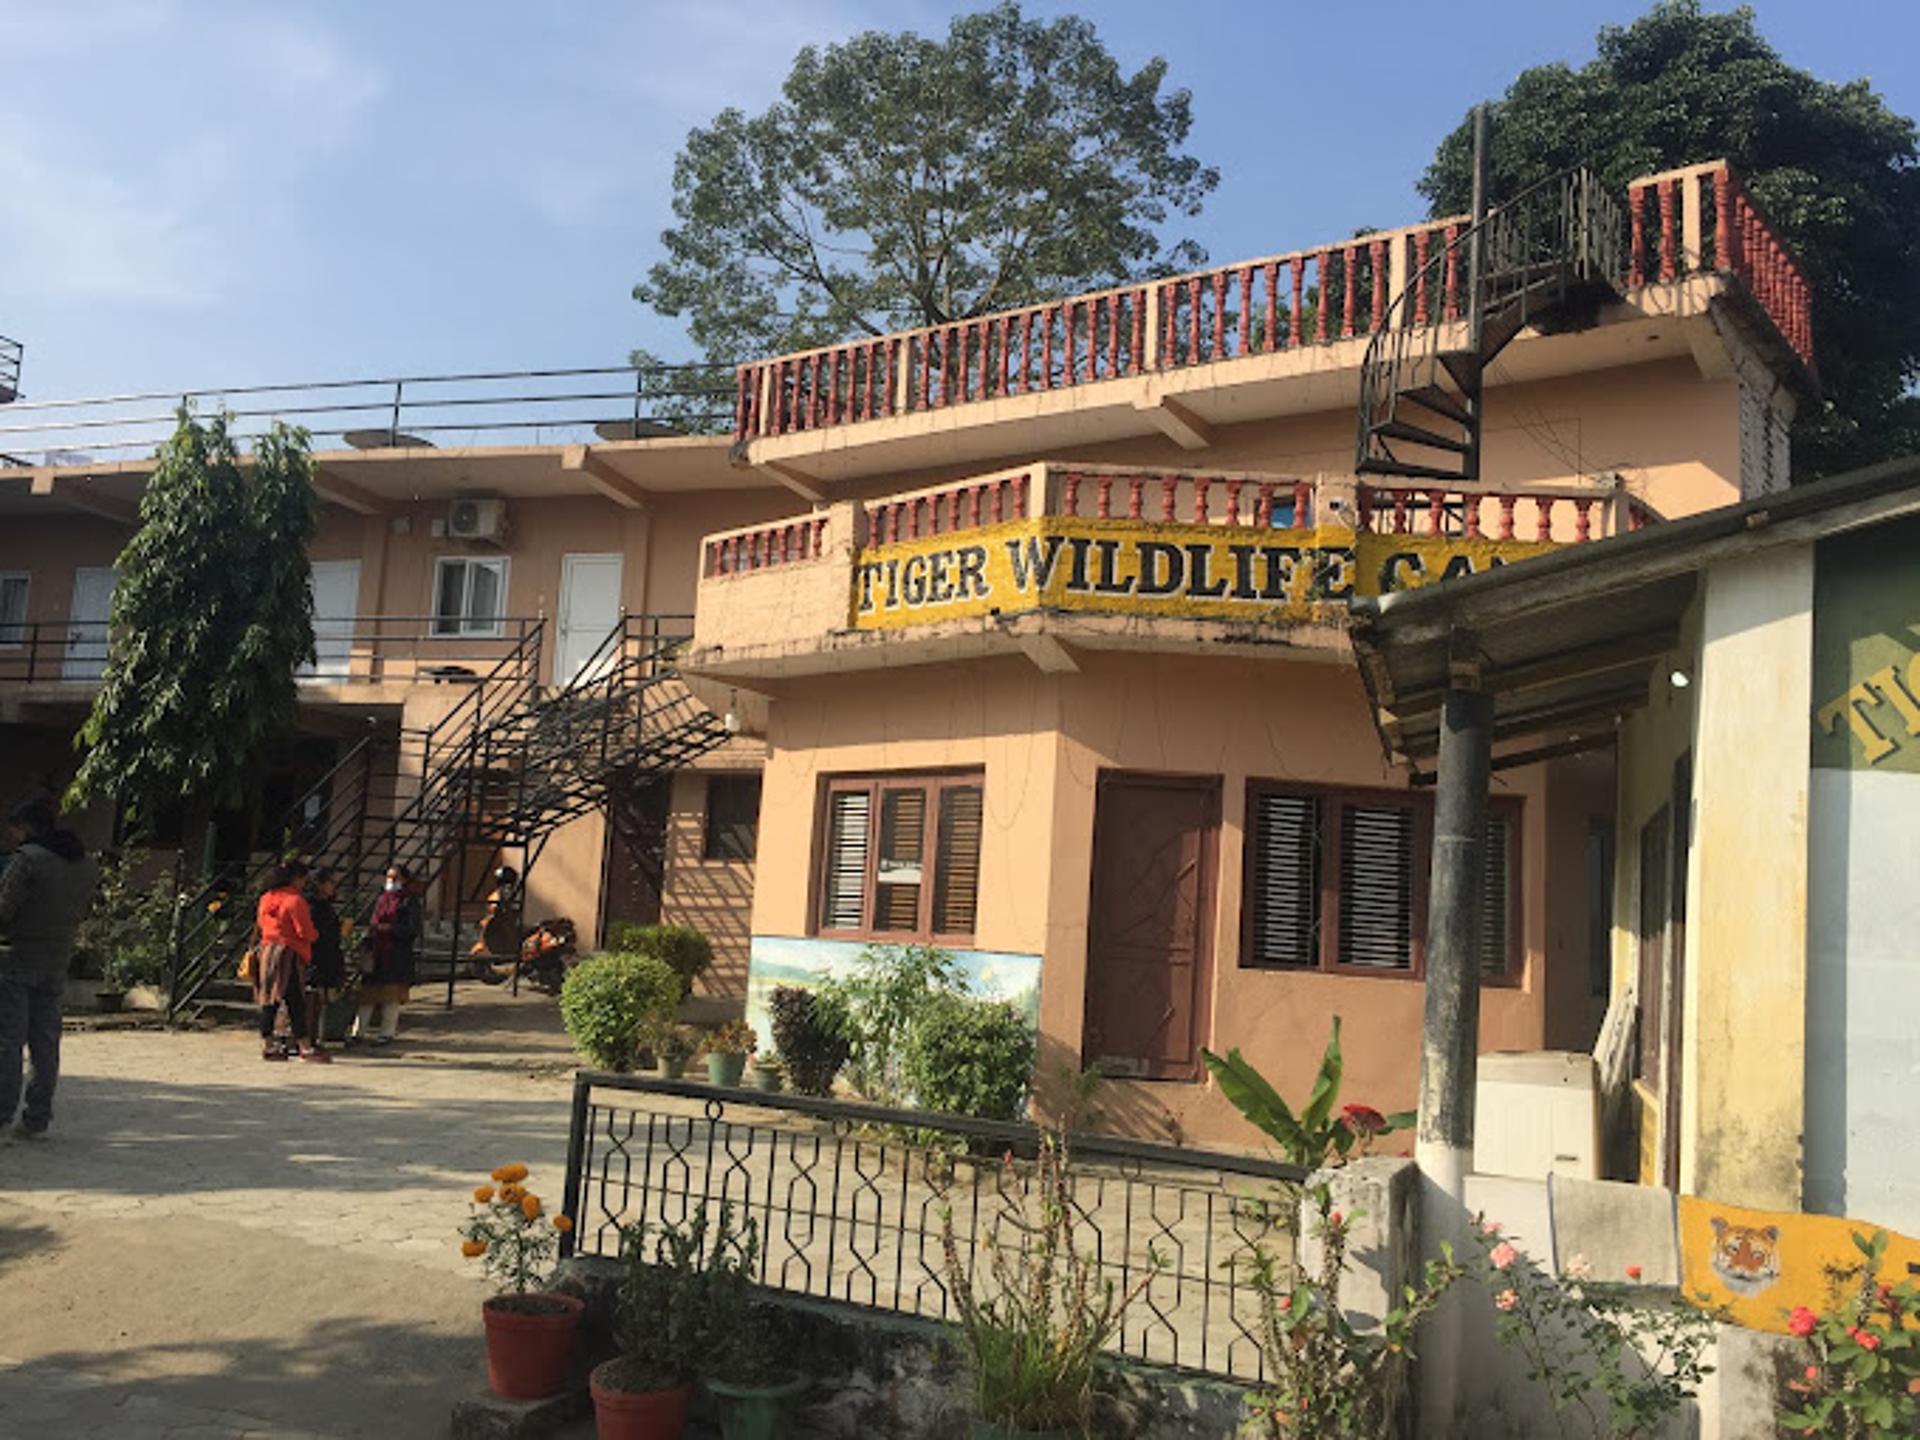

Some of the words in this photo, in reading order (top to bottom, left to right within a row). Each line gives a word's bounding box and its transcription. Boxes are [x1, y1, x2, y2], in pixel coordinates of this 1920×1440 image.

[854, 545, 990, 612] TIGER
[1005, 536, 1354, 600] WILDLIFE
[1379, 552, 1508, 594] CA
